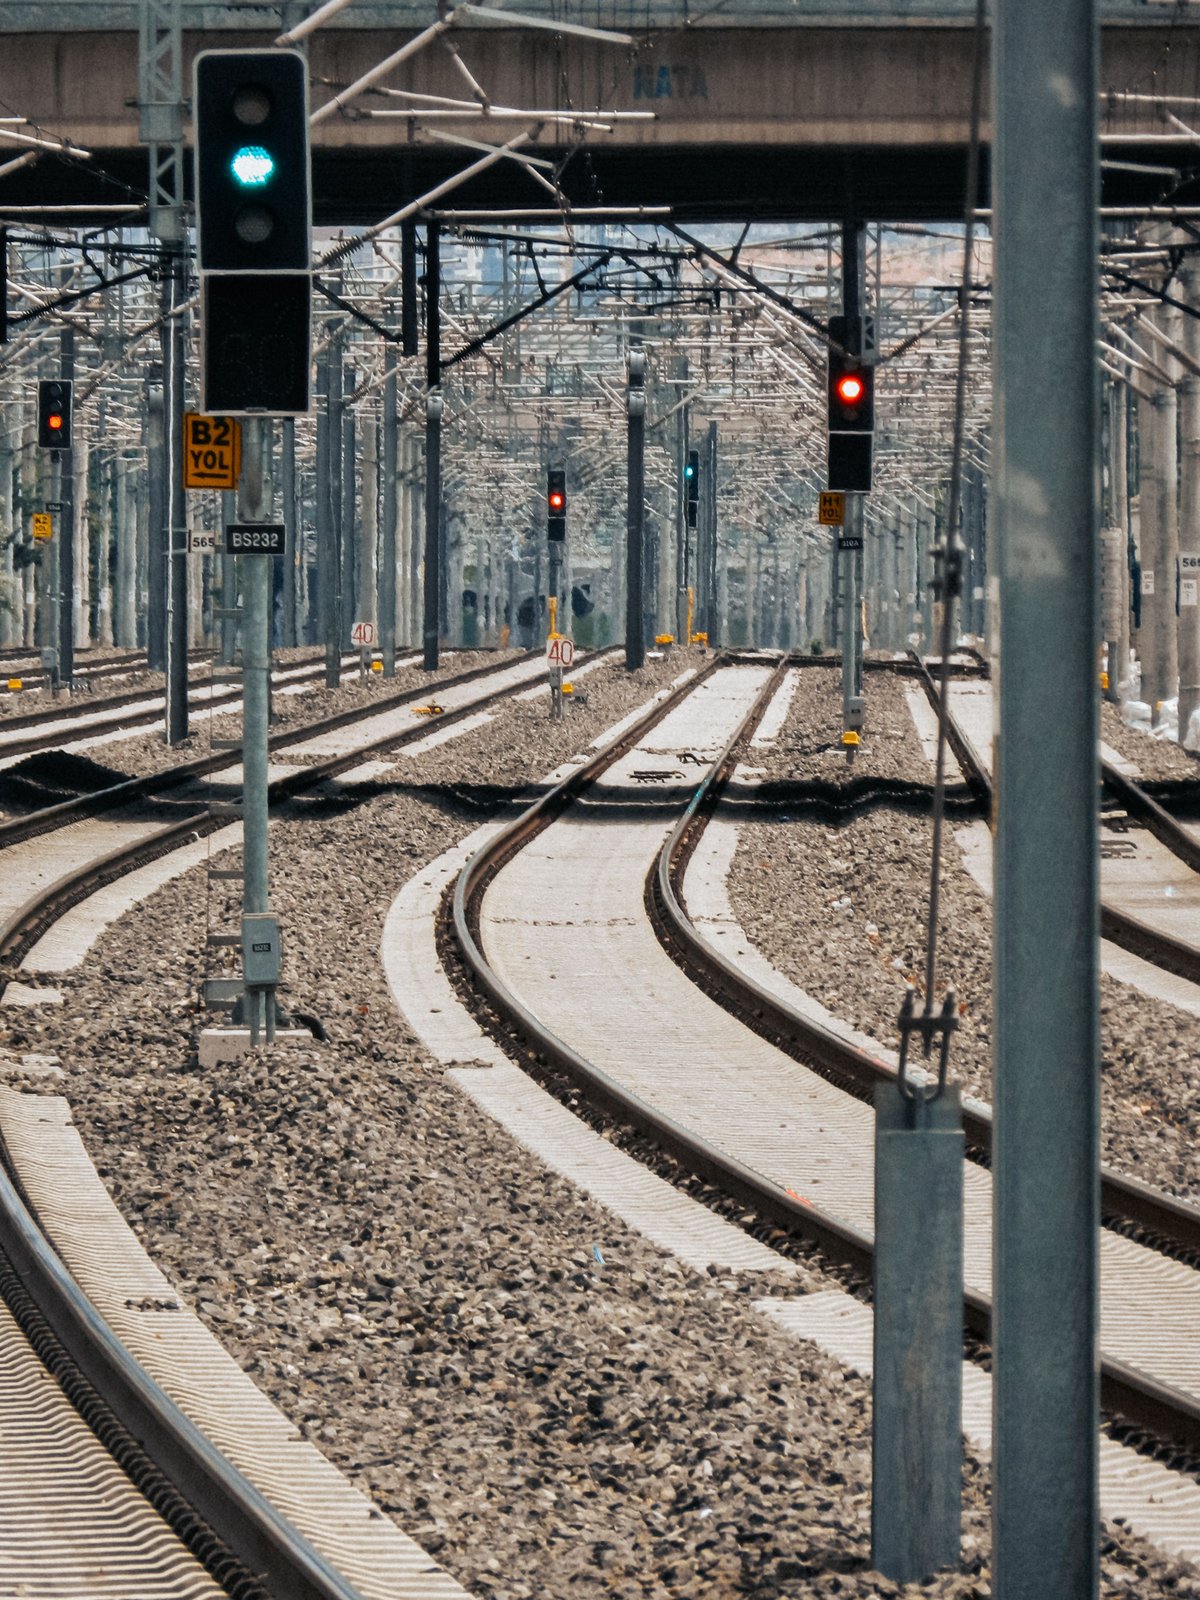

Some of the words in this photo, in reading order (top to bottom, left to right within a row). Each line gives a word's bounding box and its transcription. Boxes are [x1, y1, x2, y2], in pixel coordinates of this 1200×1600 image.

[191, 419, 230, 446] B2
[190, 450, 229, 470] YOL
[193, 537, 215, 547] 565
[232, 533, 278, 547] BS232
[352, 624, 374, 644] 40
[548, 640, 573, 666] 40
